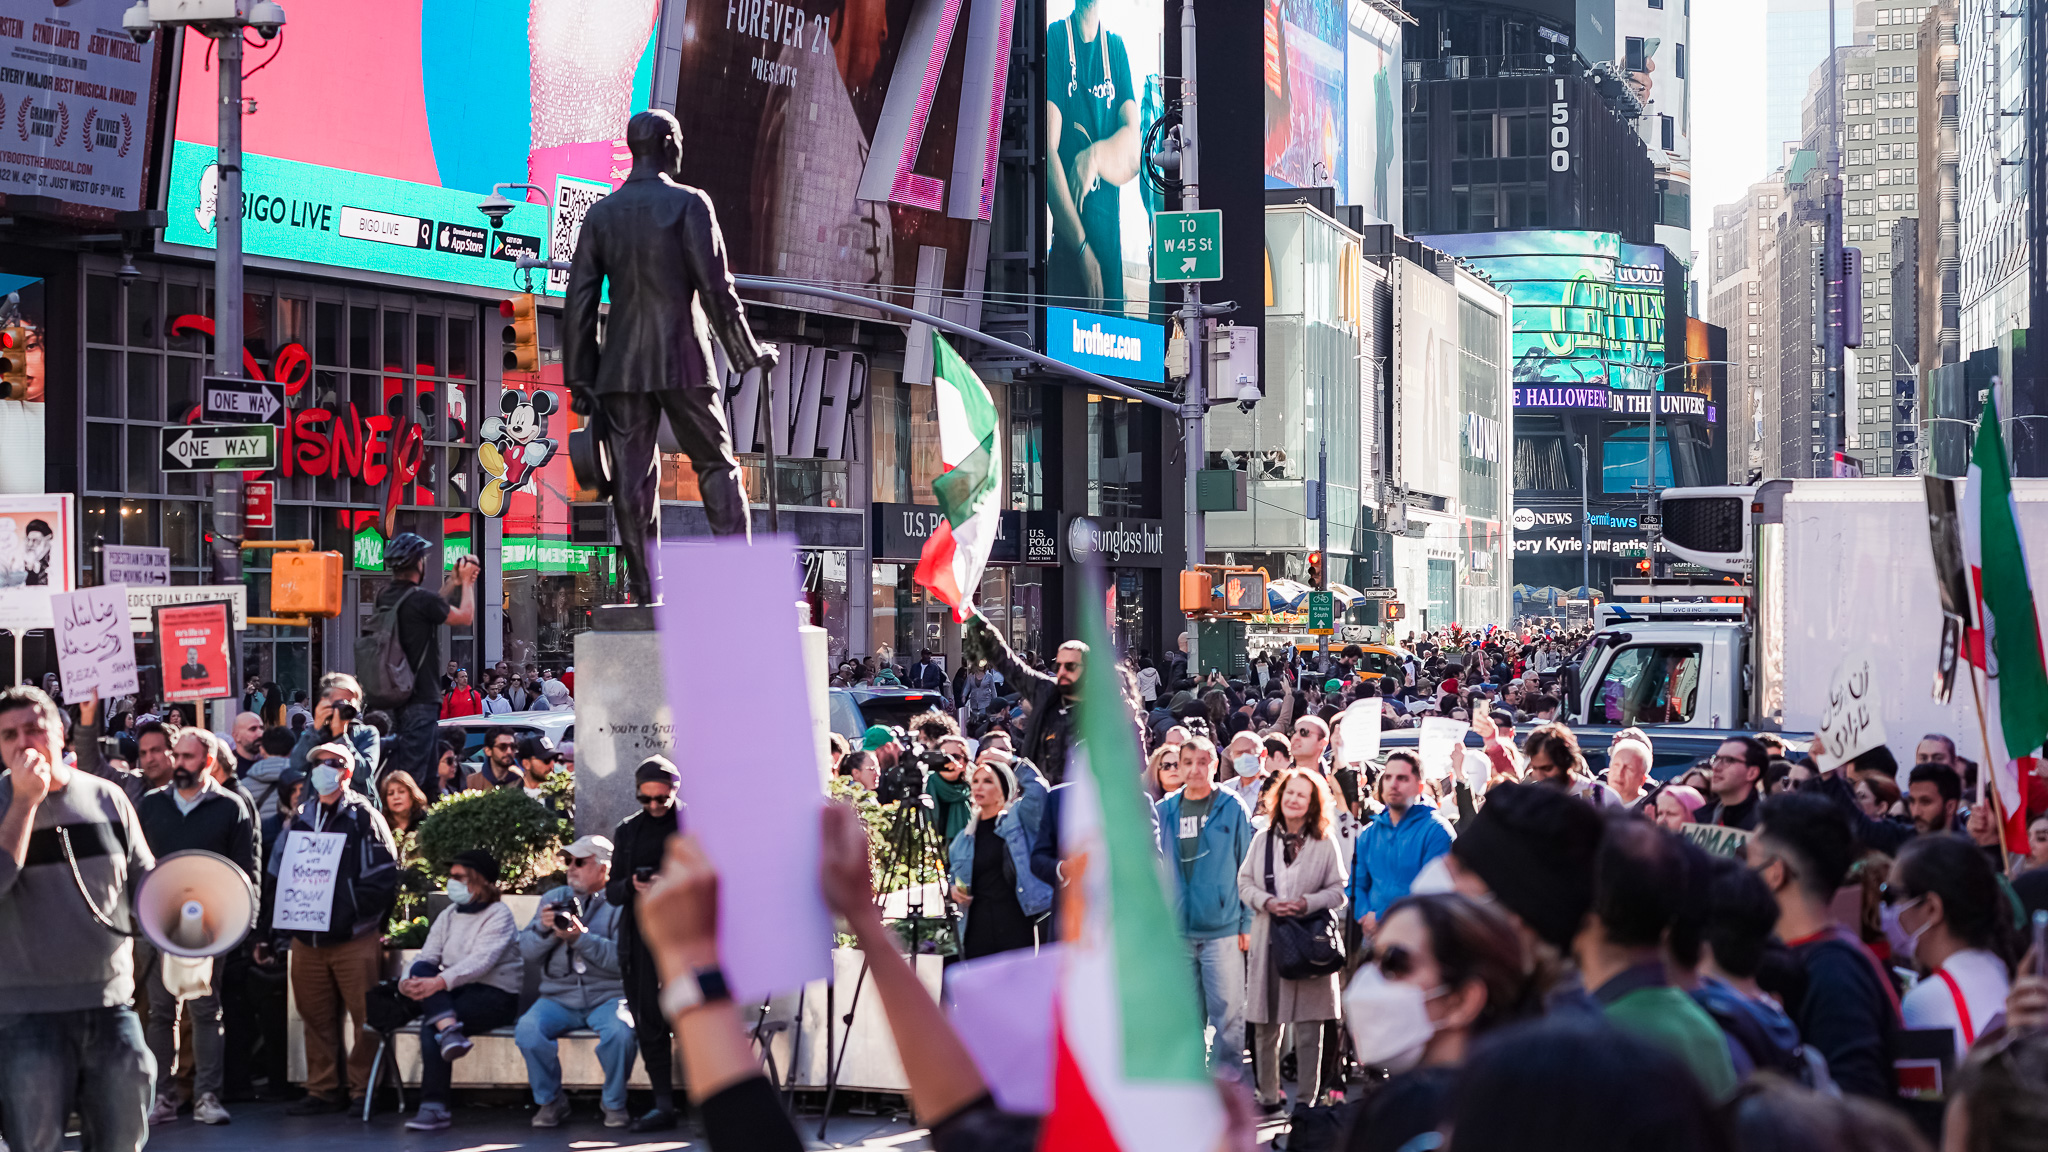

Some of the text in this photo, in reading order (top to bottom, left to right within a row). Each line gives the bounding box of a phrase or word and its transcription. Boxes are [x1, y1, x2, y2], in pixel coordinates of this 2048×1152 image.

[726, 0, 831, 55] FOREVER 21
[32, 22, 54, 45] CYNDI
[54, 28, 80, 50] LAUPER
[87, 34, 109, 57] JERRY
[751, 56, 798, 89] PRESENTS
[0, 66, 138, 106] EVERY MAJOR BEST MUSICAL AWARD!
[30, 105, 59, 123] GRAMMY
[96, 117, 120, 135] OLIVIER
[1551, 78, 1570, 172] 1500
[95, 133, 118, 149] AWARD
[12, 170, 21, 183] W.
[49, 177, 68, 190] JUST
[69, 180, 89, 193] WEST
[90, 182, 99, 194] OF
[111, 185, 126, 199] AVE.
[290, 200, 332, 232] LIVE
[359, 217, 400, 237] BIGO LIVE
[1179, 219, 1197, 233] TO
[451, 236, 484, 253] App Store
[1164, 237, 1213, 253] W 45 St
[1072, 319, 1142, 362] brother.com
[214, 392, 273, 413] ONE WAY
[1613, 394, 1624, 412] IN
[1660, 395, 1705, 415] UNIVERSE
[178, 438, 260, 458] ONE WAY
[903, 511, 927, 538] U.S.
[1515, 512, 1573, 525] abc NEWS
[1028, 529, 1046, 538] U.S.
[1028, 538, 1054, 547] POLO
[1091, 521, 1164, 562] sunglass hut
[1028, 547, 1056, 556] ASSN.
[1545, 536, 1583, 554] Kyrie
[1632, 549, 1641, 557] 45
[109, 551, 139, 566] PEDESTRIAN
[609, 722, 639, 737] You're
[641, 724, 649, 734] a
[296, 836, 336, 856] DOWN
[284, 888, 324, 902] DOWN
